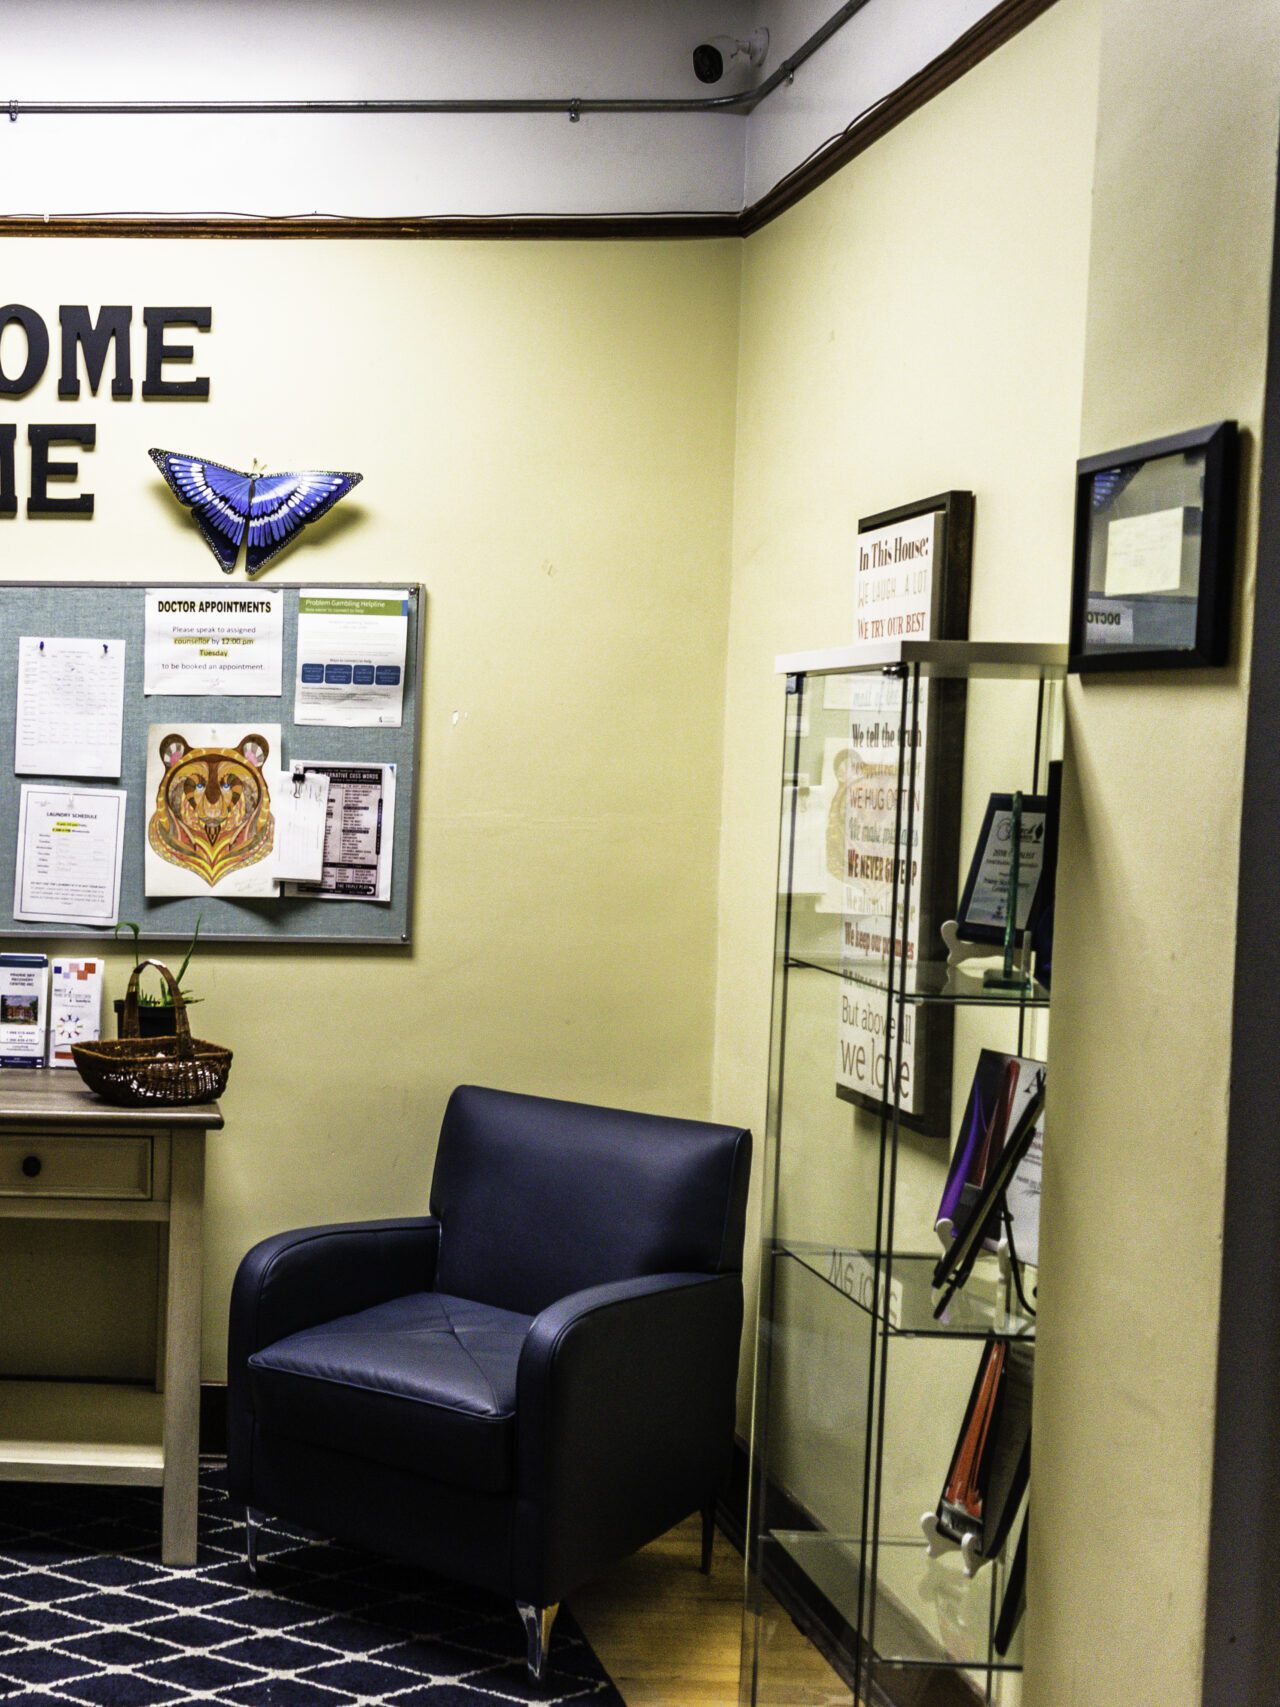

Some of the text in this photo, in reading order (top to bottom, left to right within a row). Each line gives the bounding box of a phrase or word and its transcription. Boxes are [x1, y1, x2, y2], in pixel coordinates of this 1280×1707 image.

[859, 536, 929, 572] In This House:
[858, 579, 869, 608] WE
[913, 569, 927, 594] LOT
[158, 601, 271, 613] DOCTOR APPOINTMENTS
[858, 612, 925, 640] WE TRY OUR BEST
[852, 723, 864, 748] We
[867, 722, 879, 748] tell
[882, 722, 894, 748] the
[850, 787, 863, 809] WE
[865, 788, 884, 811] HUG
[847, 849, 859, 878] WE
[860, 854, 883, 881] NEVER
[844, 922, 854, 947] We
[855, 922, 870, 957] keep
[842, 995, 859, 1027] But
[862, 1003, 896, 1040] above
[840, 1040, 866, 1081] we
